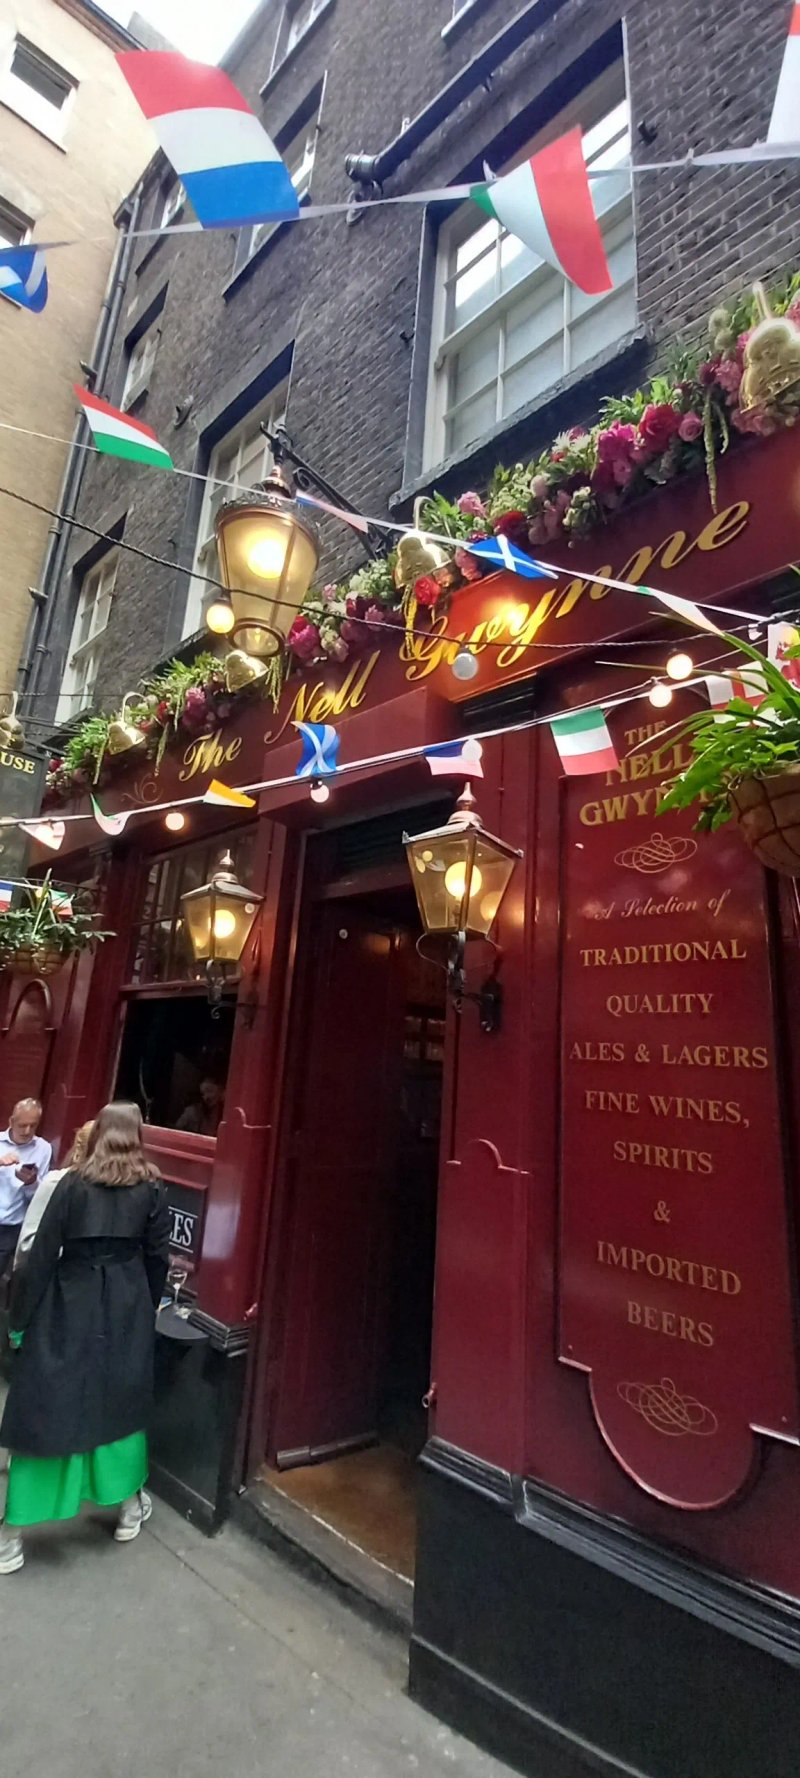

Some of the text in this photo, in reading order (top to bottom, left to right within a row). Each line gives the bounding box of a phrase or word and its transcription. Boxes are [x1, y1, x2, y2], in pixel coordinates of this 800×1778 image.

[179, 501, 750, 782] The Nell Gwynne
[620, 897, 698, 918] Selection
[707, 888, 732, 917] of
[580, 938, 747, 967] TRADITIONAL
[606, 993, 714, 1017] QUALITY
[569, 1041, 769, 1069] ALES & LAGERS
[585, 1090, 750, 1128] FINE WINES,
[613, 1140, 714, 1175] SPIRITS
[653, 1200, 671, 1223] &
[597, 1240, 742, 1295] IMPORTED
[627, 1300, 714, 1347] BEERS
